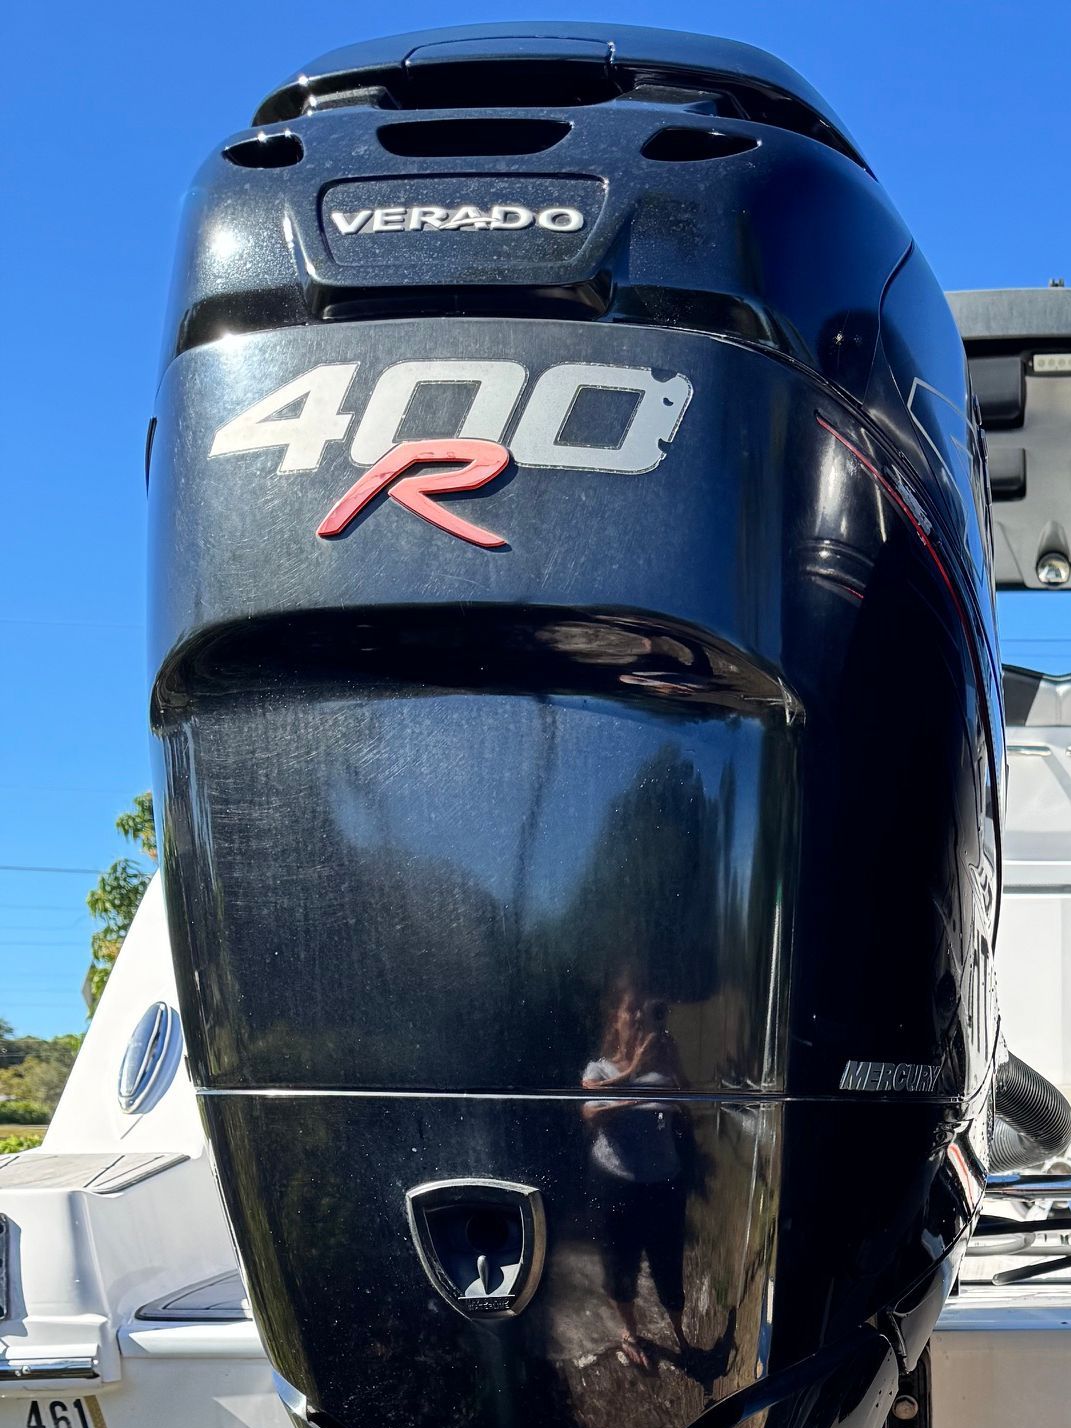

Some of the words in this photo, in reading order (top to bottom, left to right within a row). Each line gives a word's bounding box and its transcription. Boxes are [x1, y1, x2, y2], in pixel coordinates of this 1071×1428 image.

[330, 205, 585, 235] VERADO
[207, 359, 694, 475] 400
[316, 437, 508, 548] R
[840, 1060, 941, 1092] MERCURY
